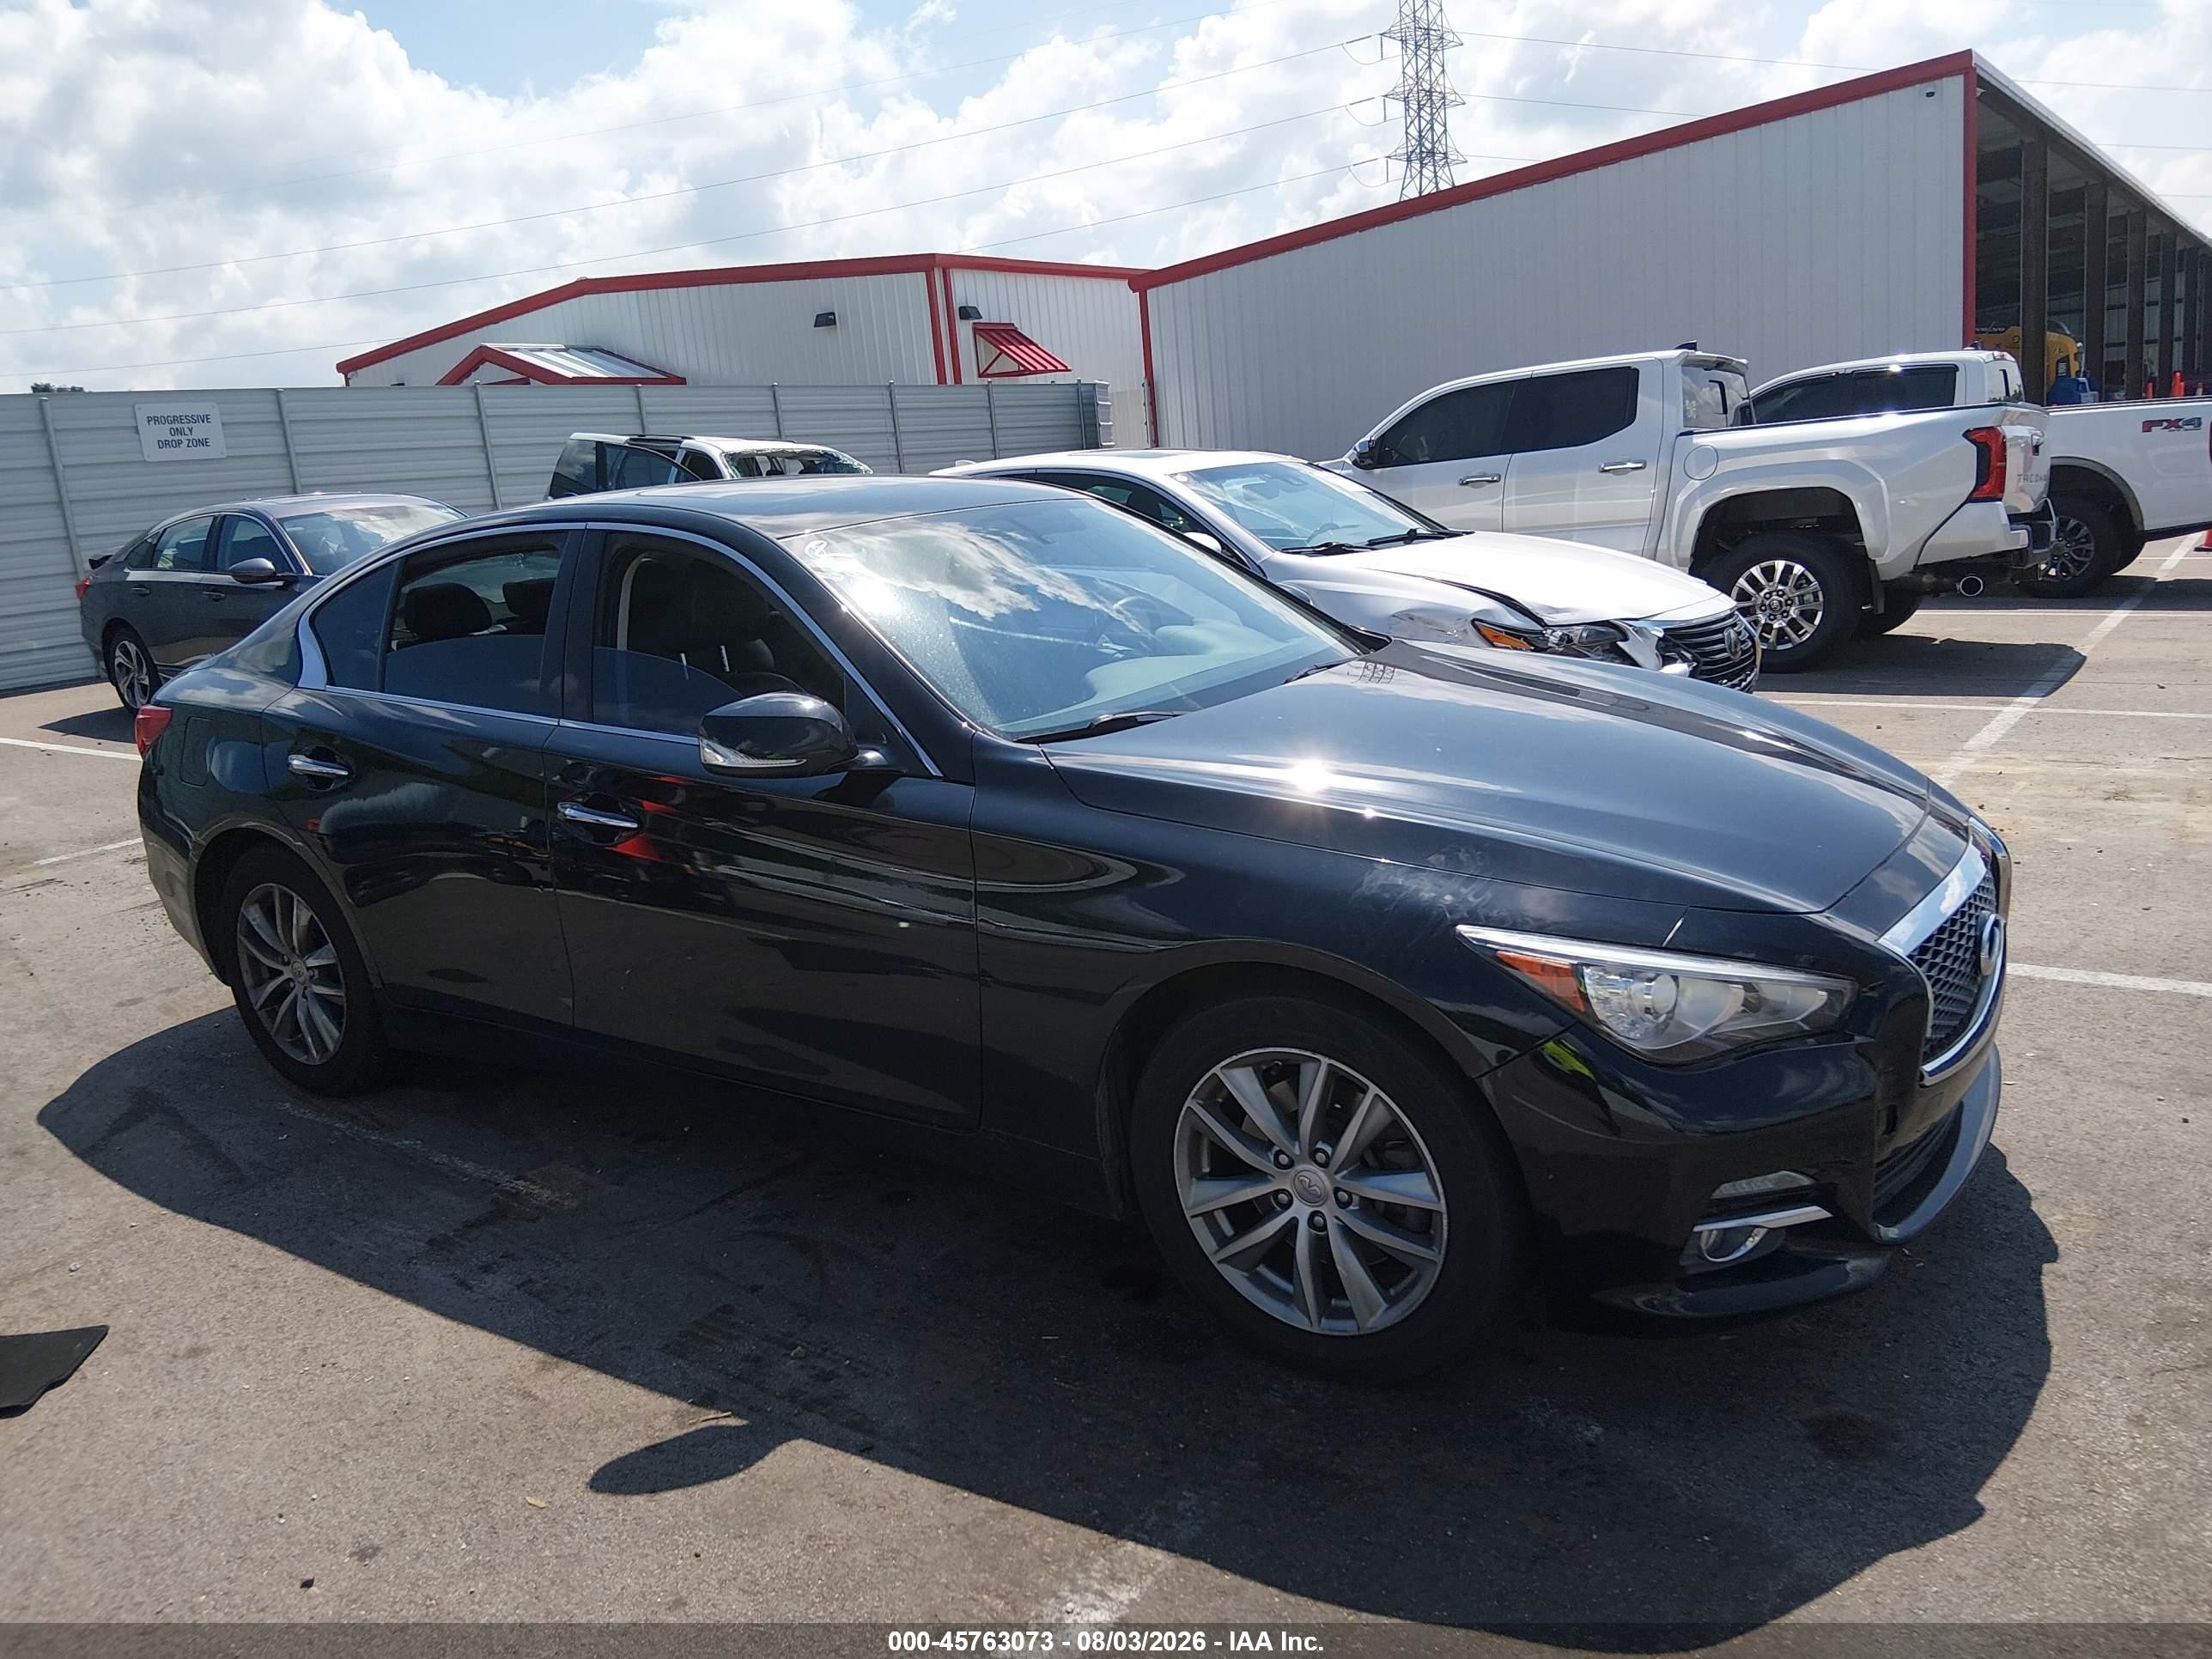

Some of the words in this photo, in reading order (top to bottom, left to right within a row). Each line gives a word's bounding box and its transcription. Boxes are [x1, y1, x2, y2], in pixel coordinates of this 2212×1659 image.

[147, 414, 212, 425] PROGRESSIVE
[2142, 417, 2202, 433] FX4
[169, 426, 193, 436] ONLY
[157, 439, 183, 449] DROP
[186, 437, 211, 447] ZONE
